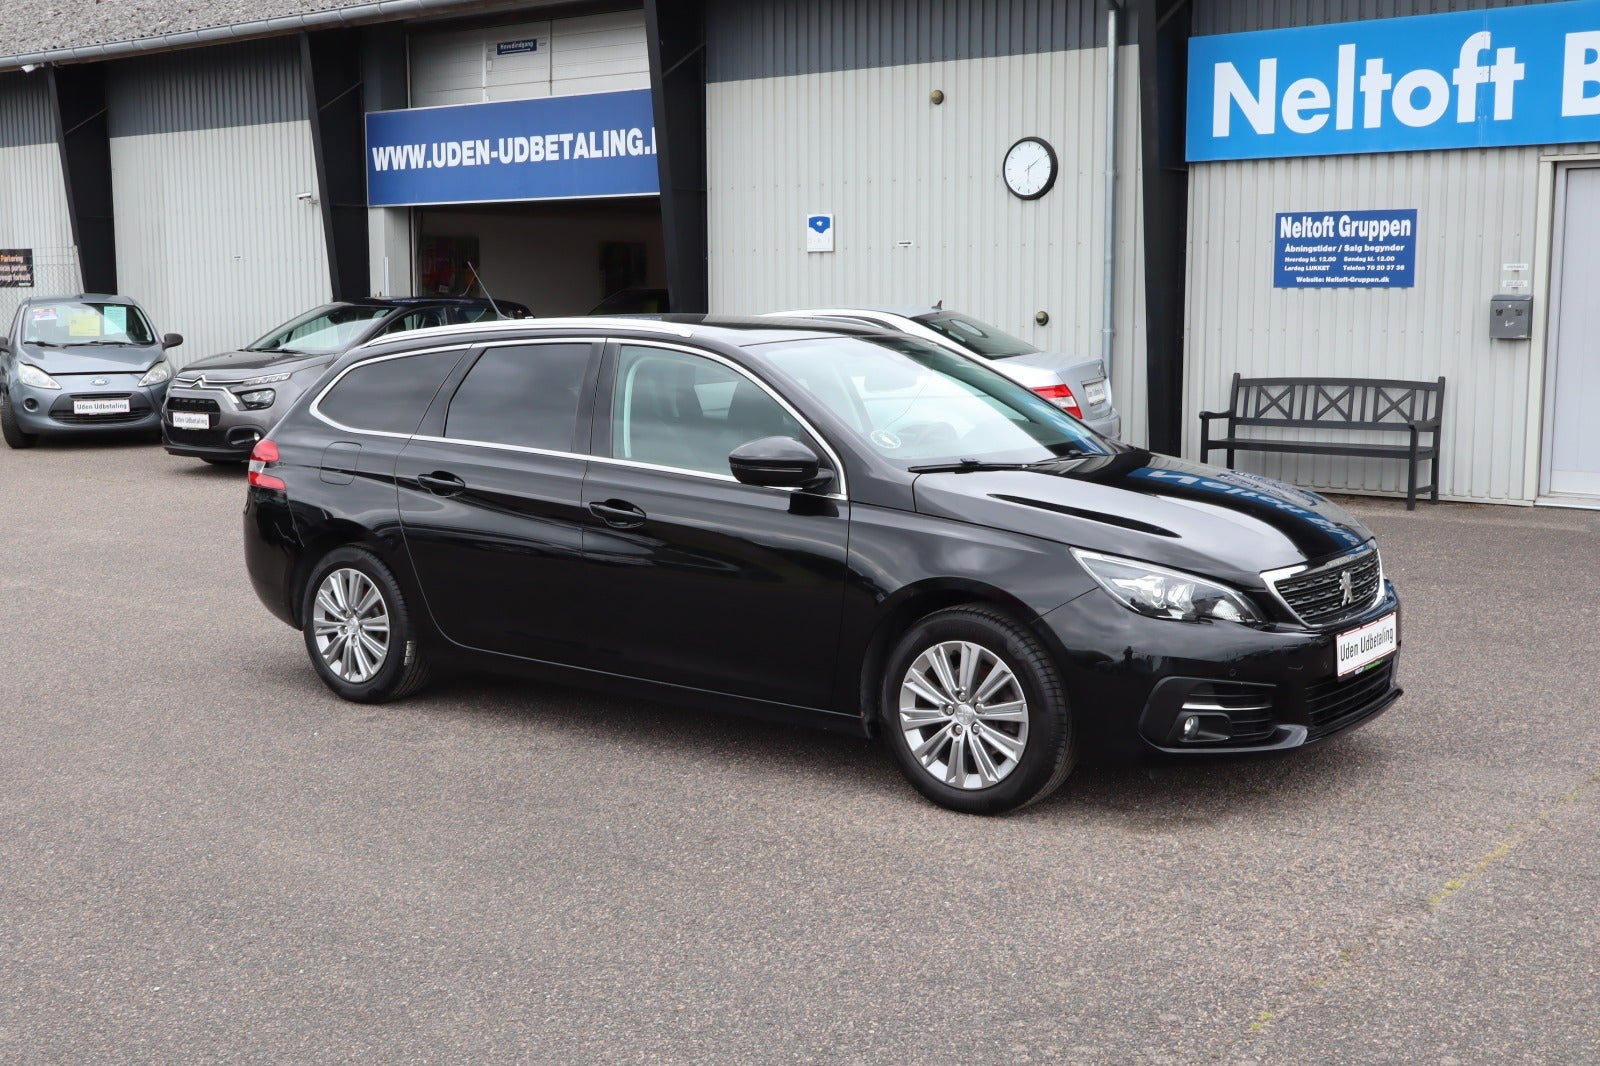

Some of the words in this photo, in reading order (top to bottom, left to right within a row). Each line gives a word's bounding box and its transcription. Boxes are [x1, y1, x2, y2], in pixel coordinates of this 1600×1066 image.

[1212, 30, 1525, 138] Neltoft
[372, 127, 657, 171] WWW.UDEN-UDBETALING.
[1280, 216, 1335, 239] Neltoft
[1338, 214, 1411, 241] Gruppen
[1284, 243, 1337, 253] Åbningstider
[1344, 244, 1363, 253] Salg
[1364, 244, 1405, 252] begynder
[94, 402, 127, 410] Udbetaling
[1340, 642, 1359, 662] Uden
[1360, 626, 1393, 653] Udbetaling
